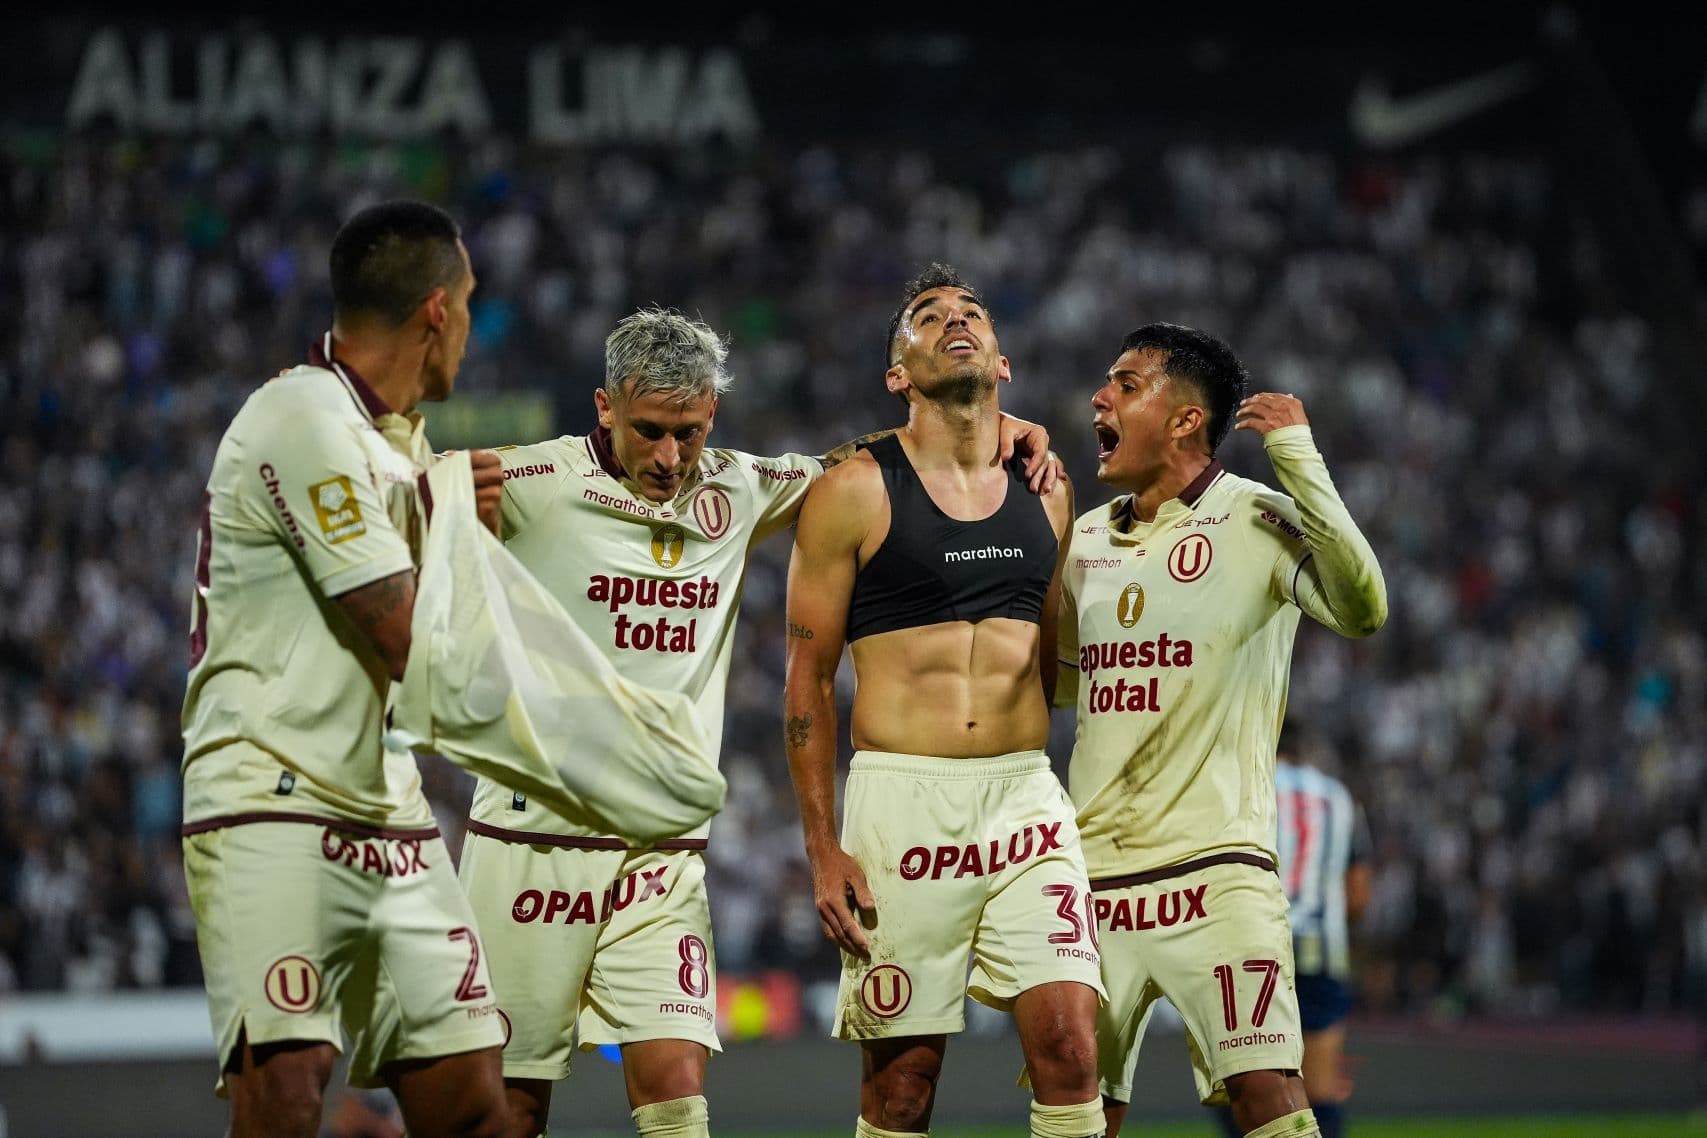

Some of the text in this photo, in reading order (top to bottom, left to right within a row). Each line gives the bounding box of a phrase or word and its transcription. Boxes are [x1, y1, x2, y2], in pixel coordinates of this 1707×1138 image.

[68, 25, 763, 144] ALIANZA LIMA
[259, 463, 306, 549] Chema
[583, 488, 655, 519] marathon
[944, 546, 1024, 562] marathon
[1075, 557, 1122, 569] marathon
[586, 573, 719, 613] apuesta
[614, 613, 697, 653] total
[1080, 632, 1194, 680] apuesta
[1089, 677, 1161, 714] total
[899, 821, 1064, 881] OPALUX
[447, 926, 488, 1001] 2
[678, 934, 709, 999] 8
[1213, 959, 1280, 1032] 17
[1219, 1031, 1286, 1051] marathon
